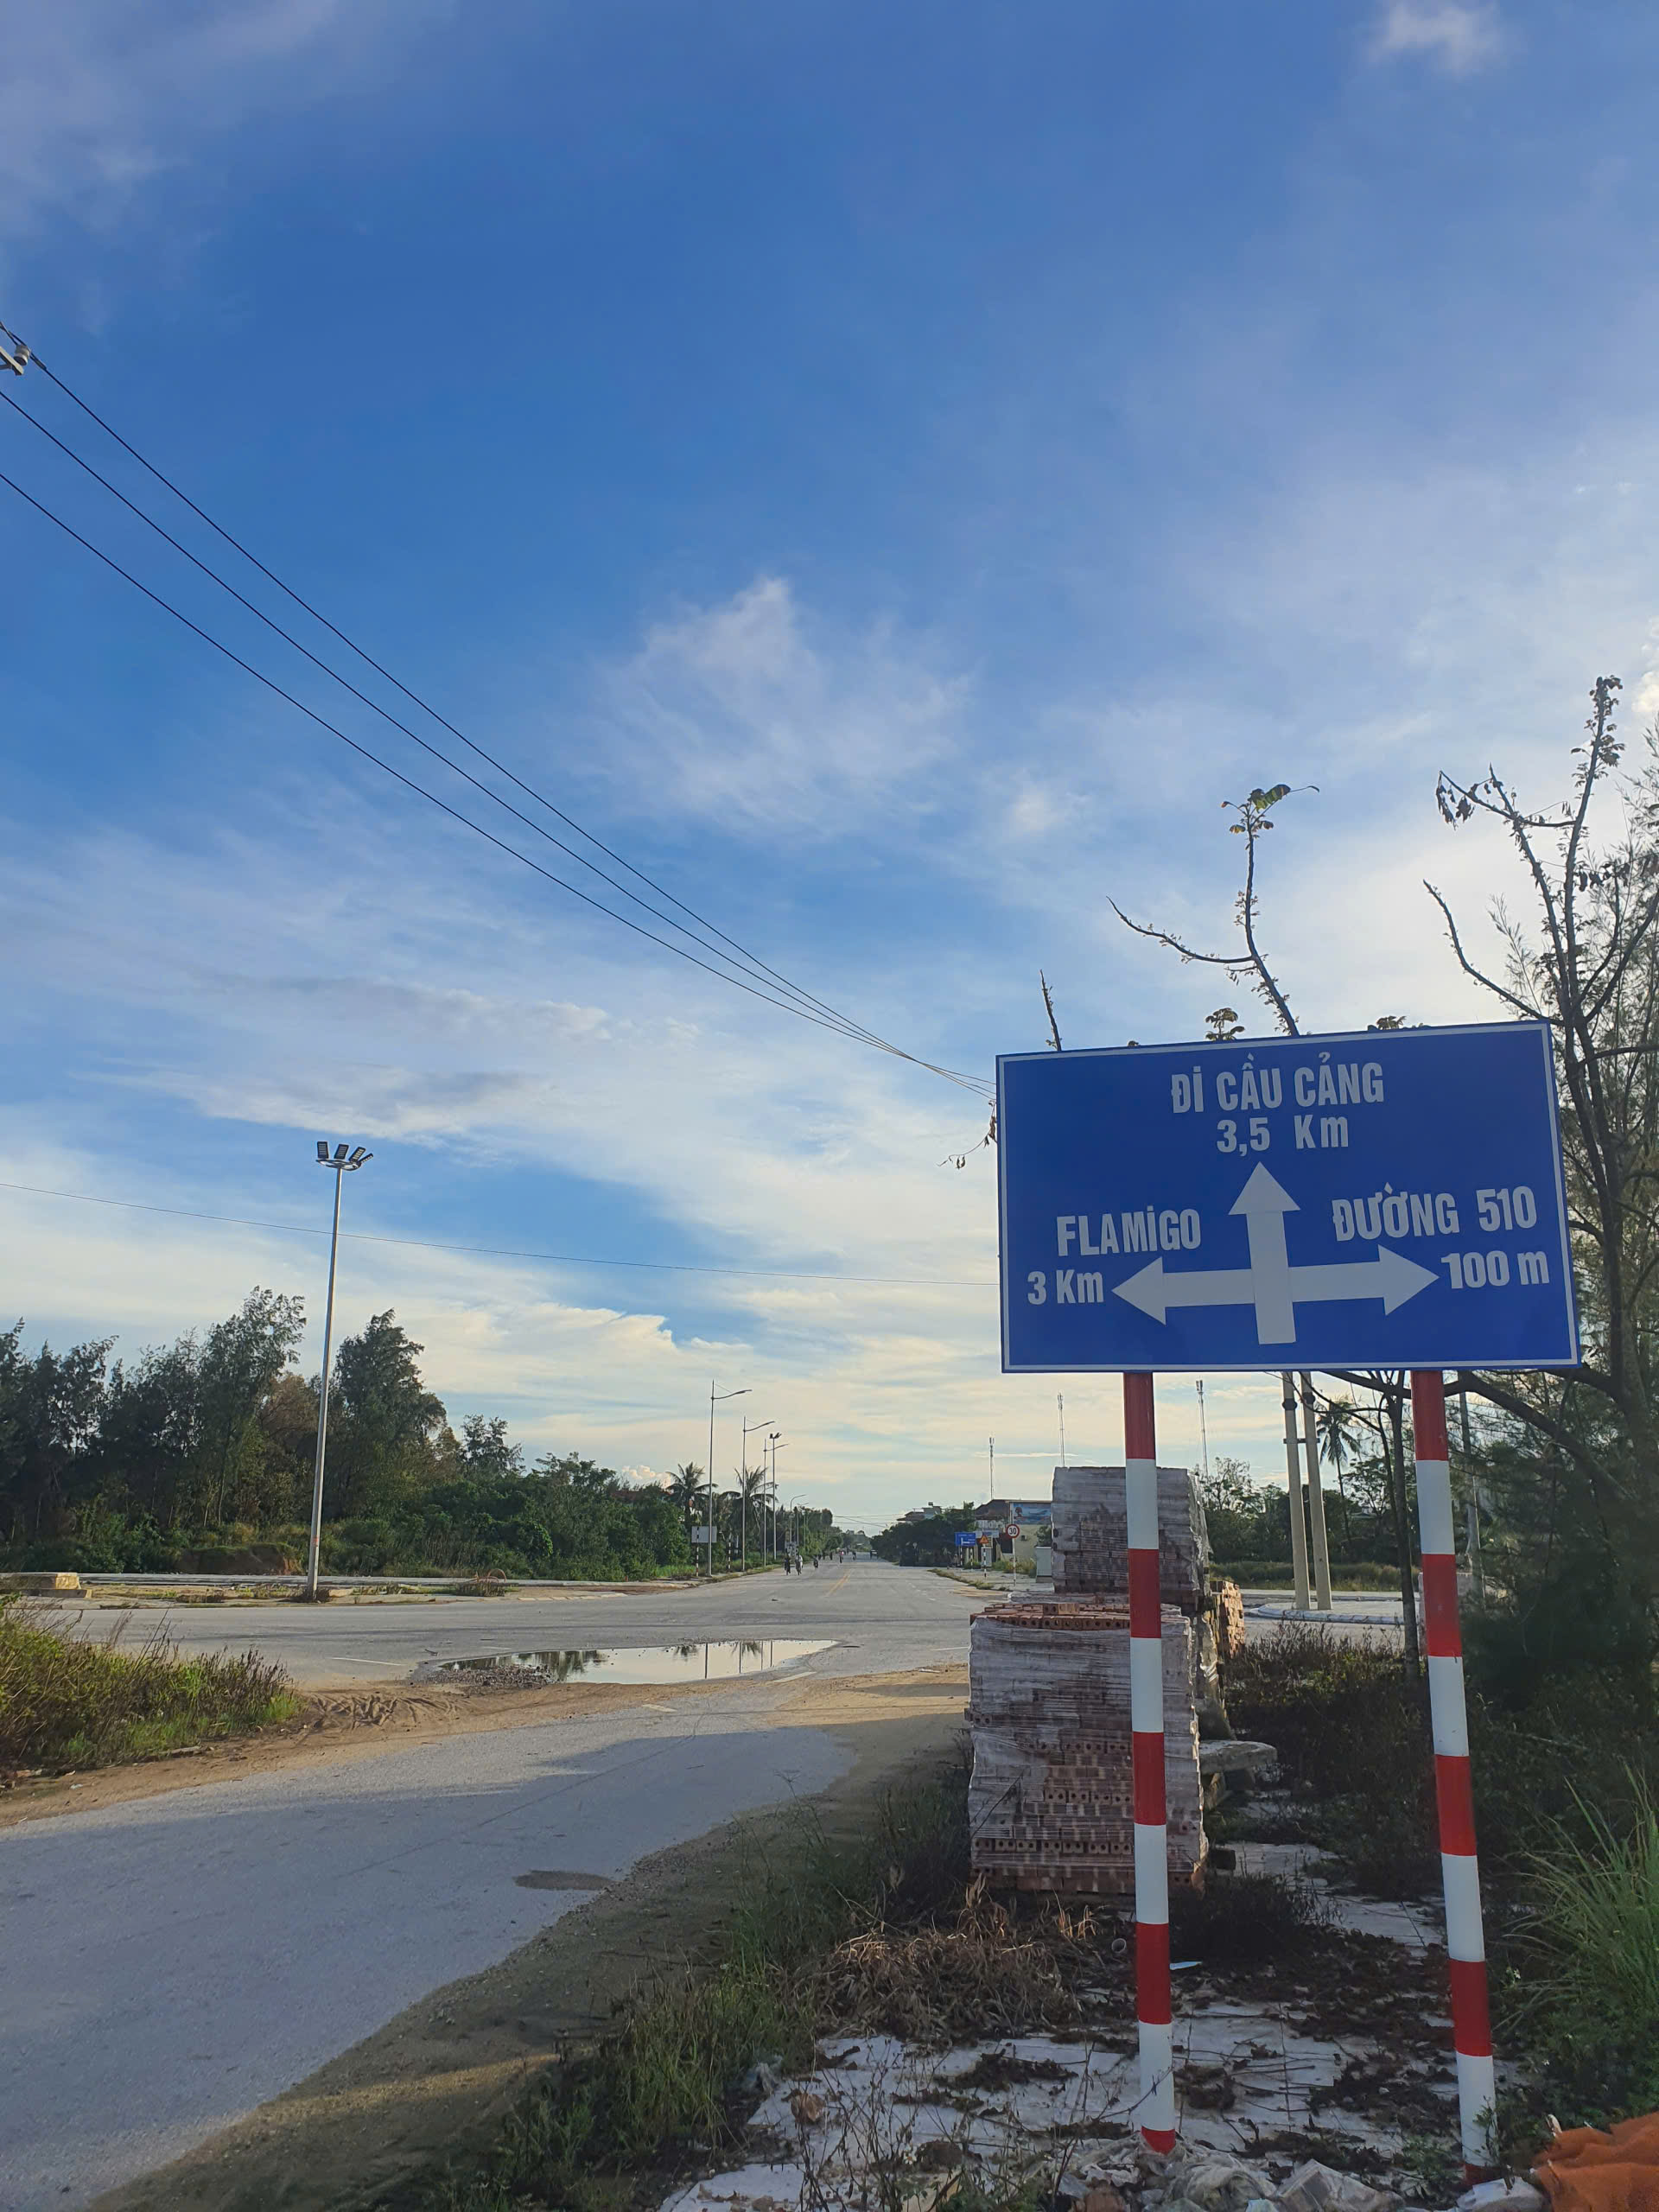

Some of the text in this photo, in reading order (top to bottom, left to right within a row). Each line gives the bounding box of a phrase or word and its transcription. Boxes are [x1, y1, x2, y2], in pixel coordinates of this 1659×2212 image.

[1216, 1052, 1283, 1110] CẦU
[1294, 1052, 1384, 1107] CẢNG
[1217, 1114, 1349, 1157] 3,5 Km
[1332, 1181, 1537, 1242] ĐƯỜNG 510
[1027, 1268, 1104, 1306] 3 Km
[1440, 1250, 1550, 1289] 100 m
